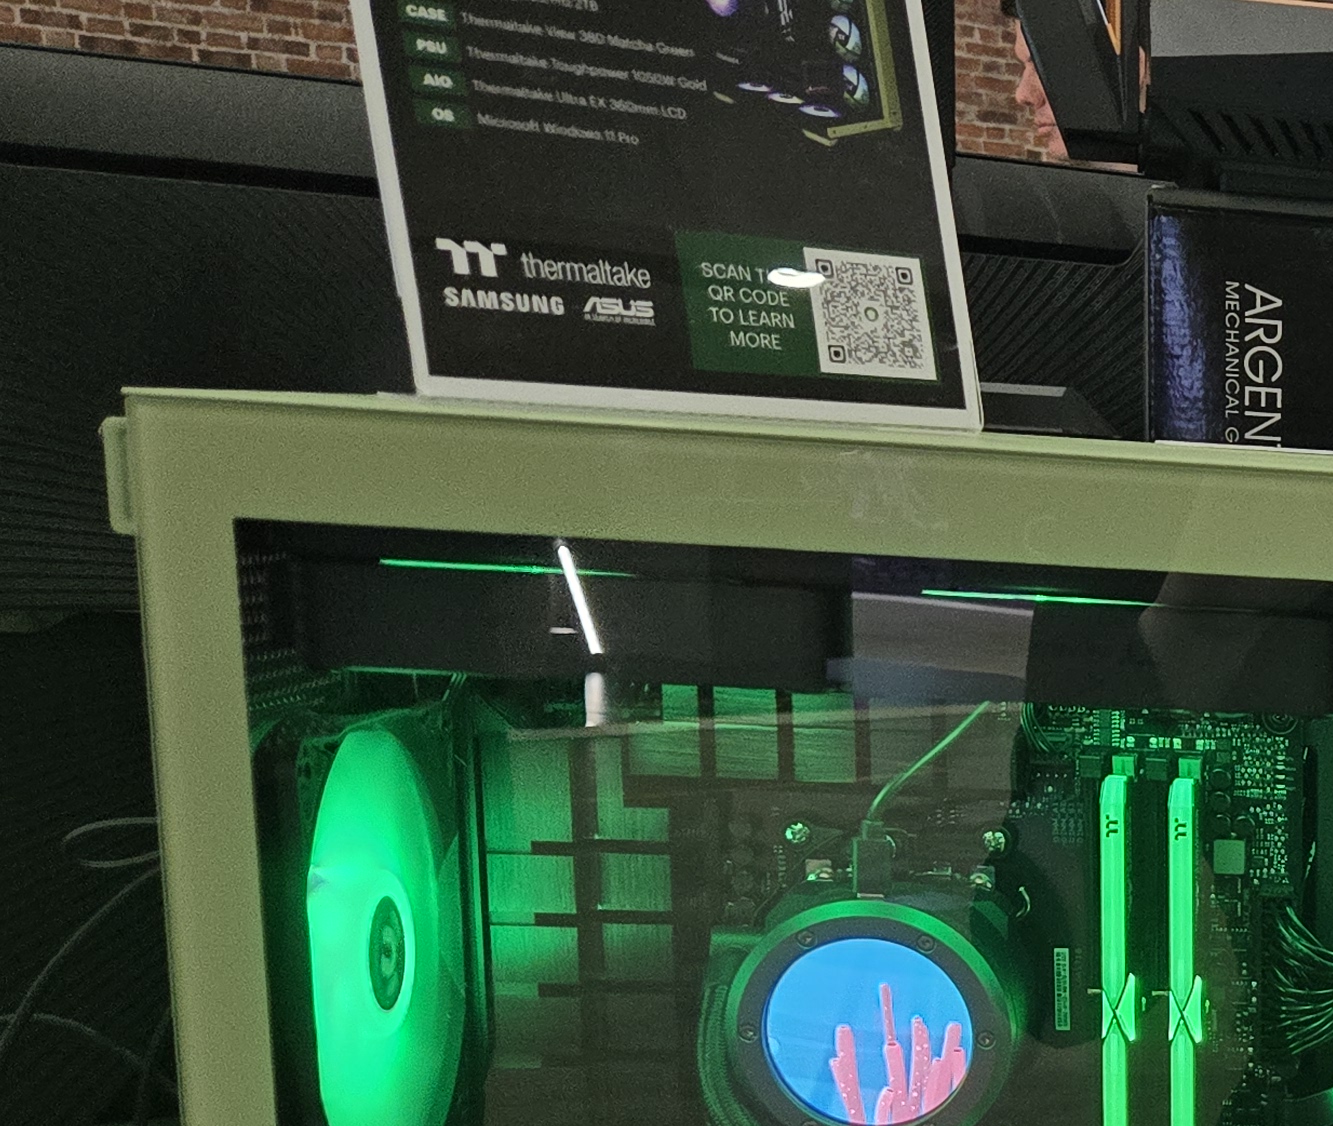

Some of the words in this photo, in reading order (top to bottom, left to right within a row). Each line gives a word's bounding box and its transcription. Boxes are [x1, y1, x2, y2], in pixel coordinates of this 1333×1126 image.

[405, 4, 449, 22] CASE
[416, 38, 447, 55] PSU
[423, 73, 453, 89] AIO
[431, 107, 455, 122] OS
[660, 105, 688, 120] LCD
[617, 131, 640, 146] Pro
[520, 252, 651, 289] thermaltake
[701, 262, 752, 282] SCAN
[443, 286, 565, 315] SAMSUNG
[583, 296, 655, 317] ASUS
[708, 285, 735, 302] QR
[739, 287, 791, 307] CODE
[708, 307, 734, 324] TO
[739, 309, 795, 329] LEARN
[730, 330, 782, 351] MORE
[1225, 281, 1240, 419] MECHANICAL
[1244, 283, 1283, 448] ARGEN
